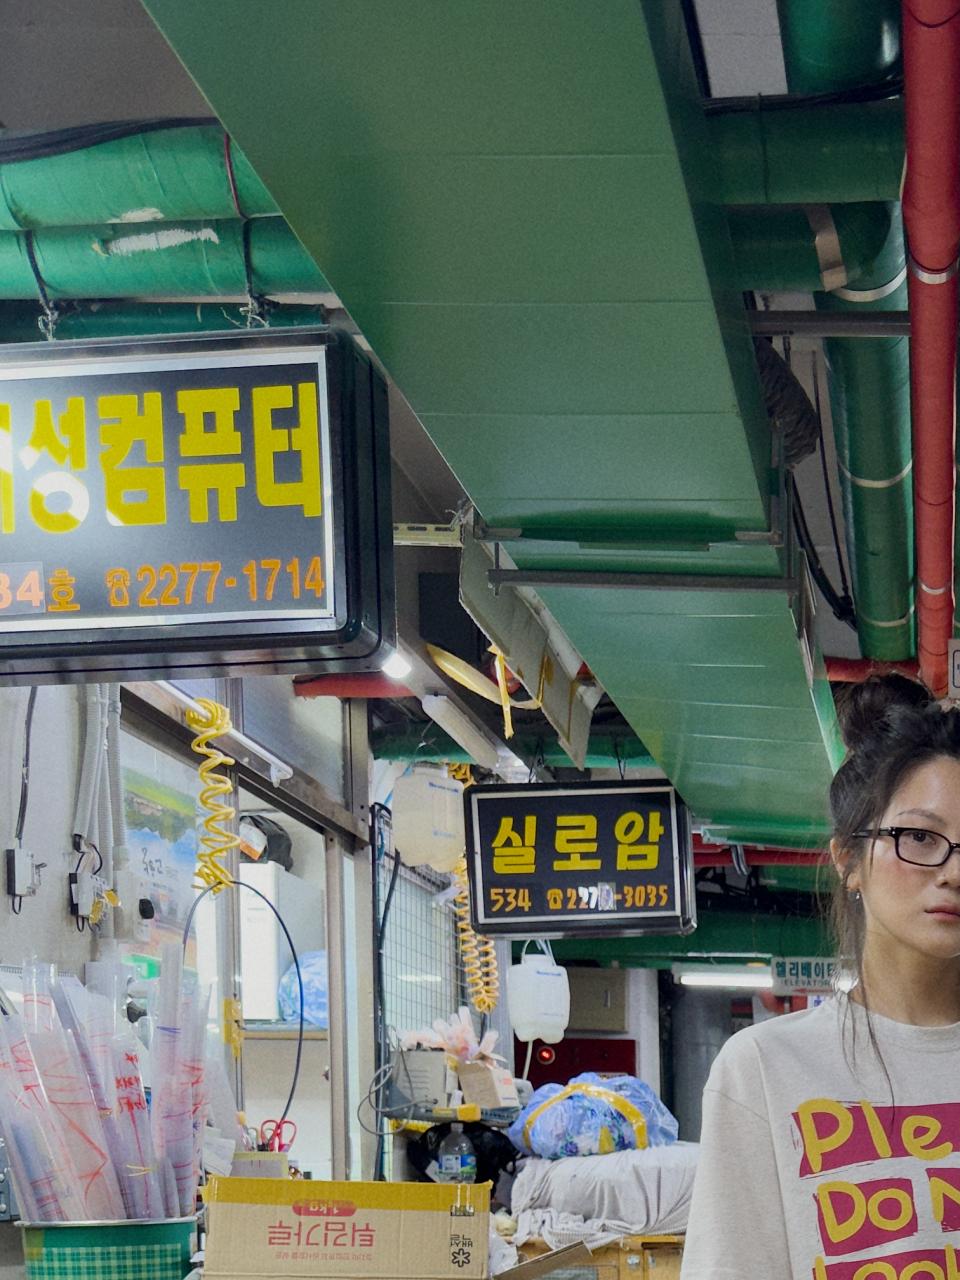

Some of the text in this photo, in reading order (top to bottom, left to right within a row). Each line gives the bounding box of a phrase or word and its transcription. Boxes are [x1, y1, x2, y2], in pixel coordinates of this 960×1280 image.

[0, 382, 322, 534] 성컴퓨터
[137, 557, 325, 607] 2277-1714
[491, 811, 665, 874] 실로암
[490, 883, 668, 912] 534 227-3035
[267, 1221, 376, 1248] 튀김가루
[816, 1181, 914, 1243] Do
